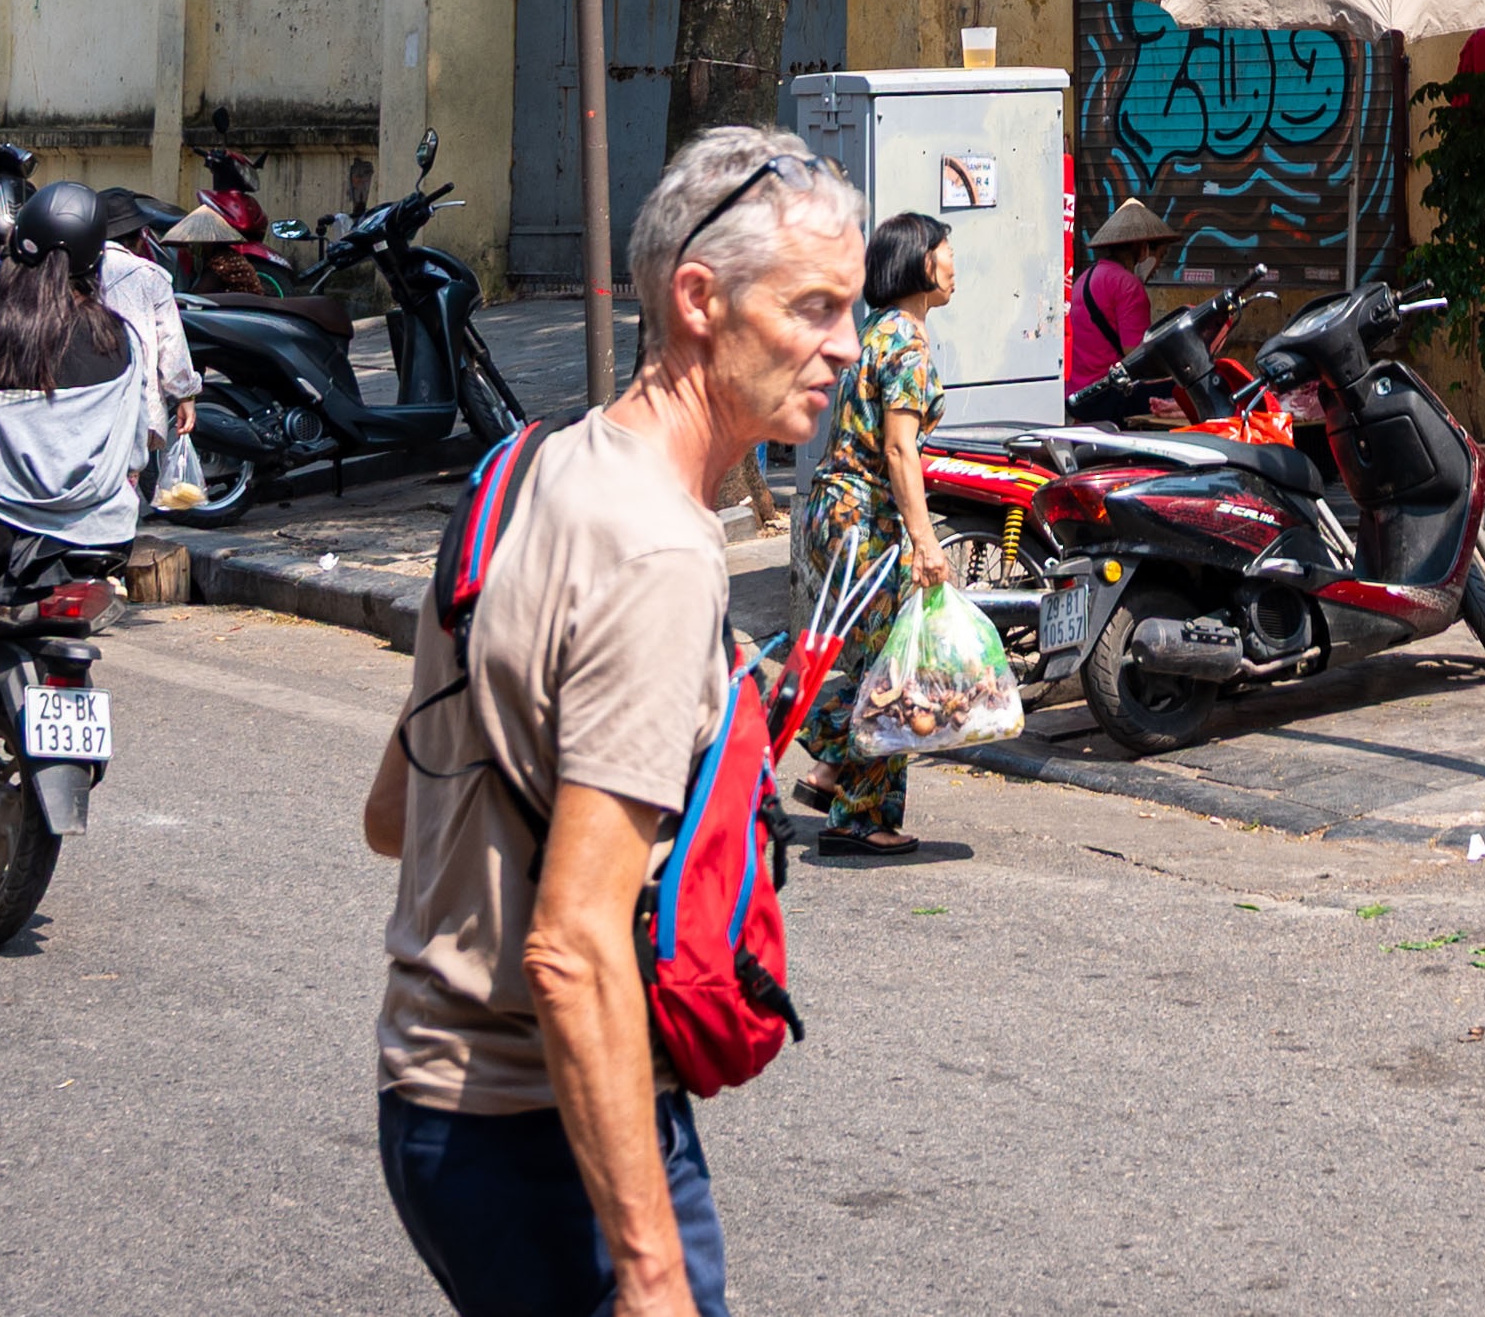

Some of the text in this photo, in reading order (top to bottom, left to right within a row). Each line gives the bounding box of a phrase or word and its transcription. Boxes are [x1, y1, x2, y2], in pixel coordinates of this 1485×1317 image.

[1047, 589, 1080, 622] 29-B1
[1043, 615, 1083, 648] 105.57
[39, 692, 98, 722] 29-BK
[35, 723, 106, 754] 133.87
